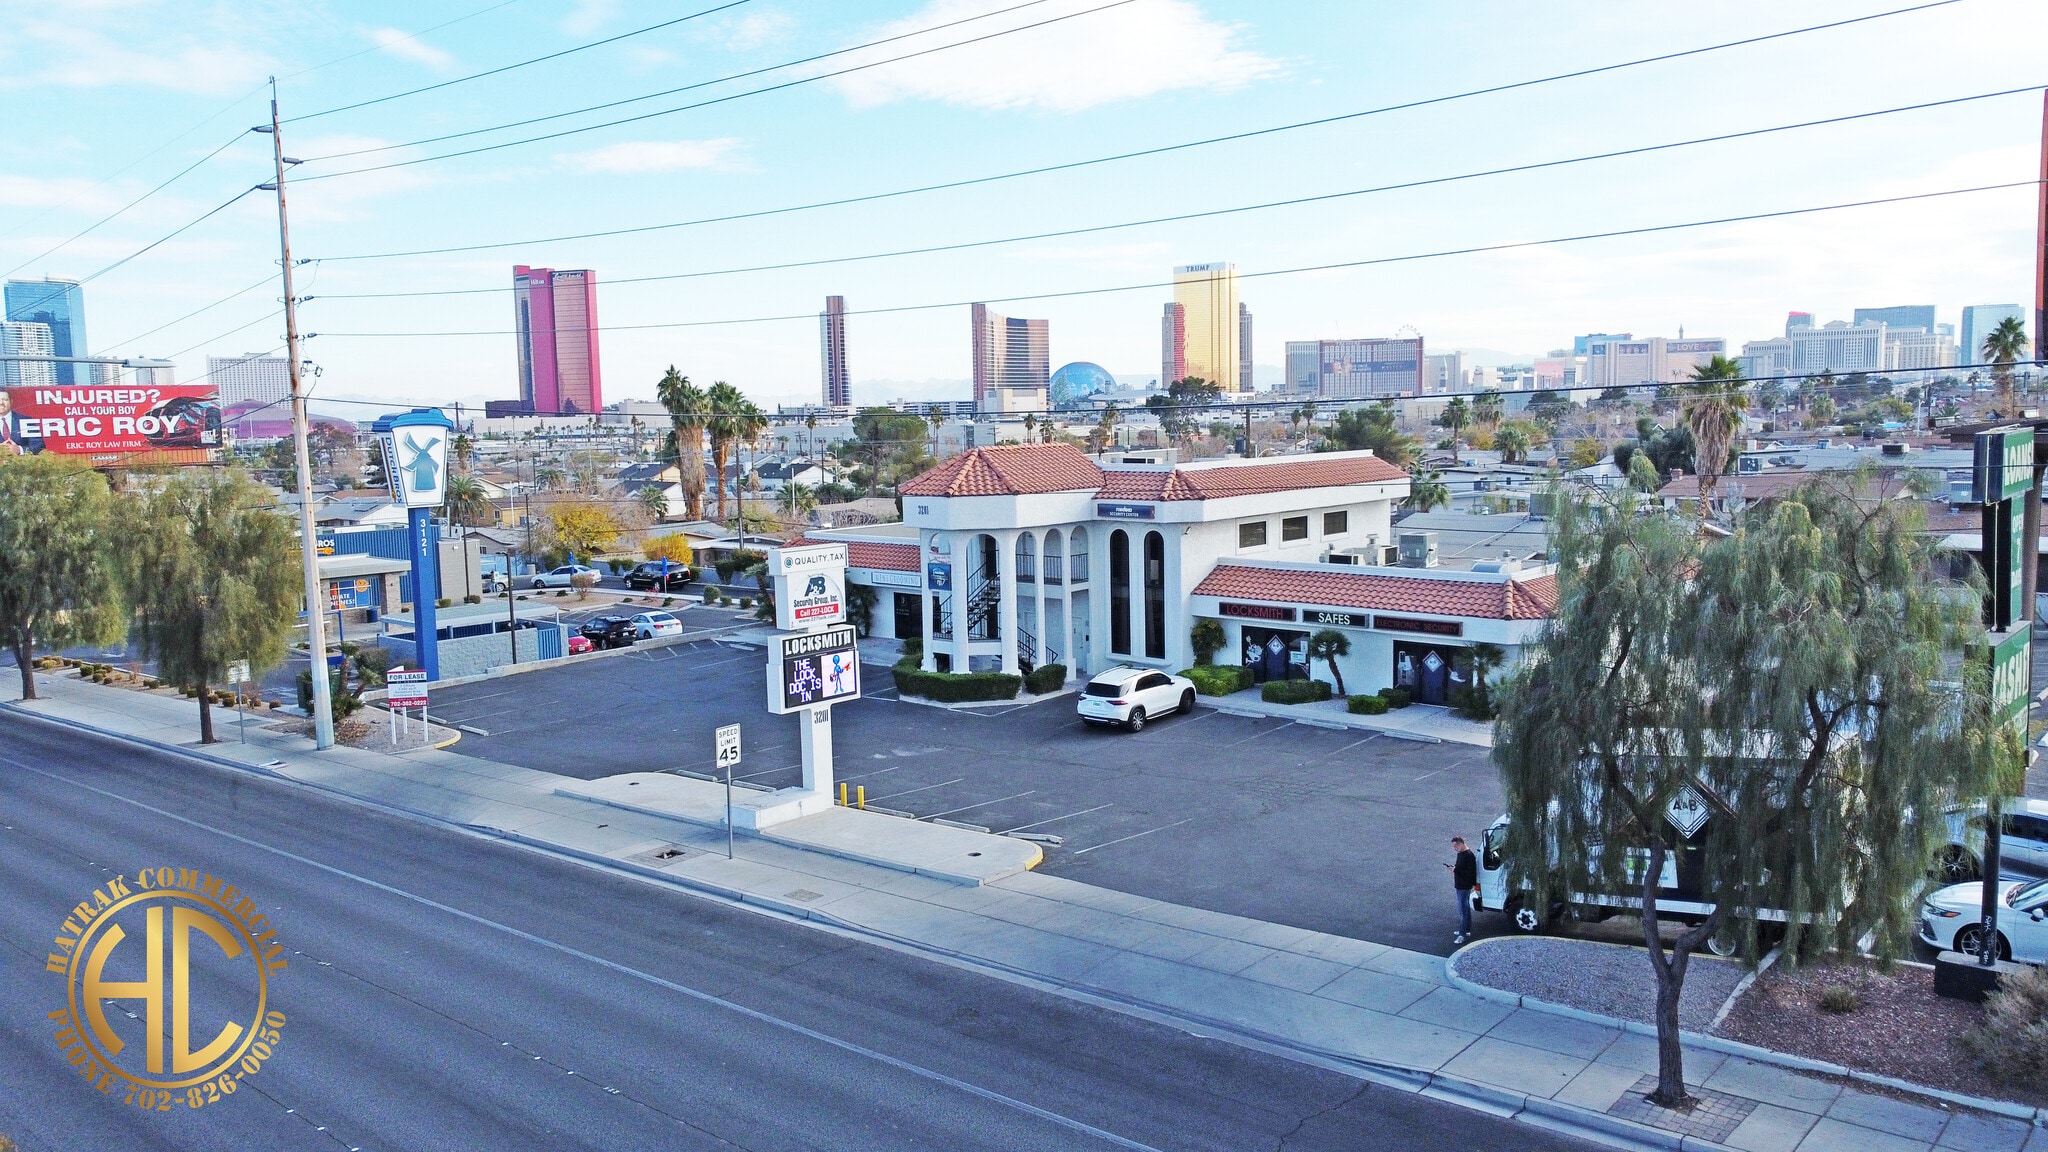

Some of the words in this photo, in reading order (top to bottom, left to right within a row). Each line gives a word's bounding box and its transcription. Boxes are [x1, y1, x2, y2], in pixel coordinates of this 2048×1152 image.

[1186, 264, 1210, 273] TRUMP
[1677, 343, 1700, 351] LOVE
[35, 389, 161, 405] INJURED?
[65, 406, 89, 416] CALL
[90, 406, 117, 416] YOUR
[118, 405, 136, 415] BOY
[19, 418, 102, 438] ERIC
[113, 414, 182, 436] ROY
[66, 442, 84, 450] ERIC
[86, 441, 102, 449] ROY
[122, 440, 141, 448] FIRM
[385, 437, 397, 474] DUTCH
[420, 518, 428, 557] 3121
[793, 598, 813, 608] Security
[800, 609, 810, 617] Call
[1226, 604, 1284, 619] LOCKSMITH
[1318, 612, 1351, 625] SAFES
[1376, 618, 1420, 630] ELECTRONIC
[1423, 623, 1457, 633] SECURITY
[785, 630, 851, 656] LOCKSMITH
[793, 658, 811, 671] THE
[794, 667, 817, 682] LOCK
[789, 681, 807, 694] DOC
[811, 677, 822, 690] IS
[801, 690, 812, 703] IN
[813, 709, 829, 724] 3201
[719, 728, 738, 738] SPEED
[720, 737, 736, 747] LIMIT
[719, 745, 738, 762] 45
[1673, 799, 1697, 811] A&B
